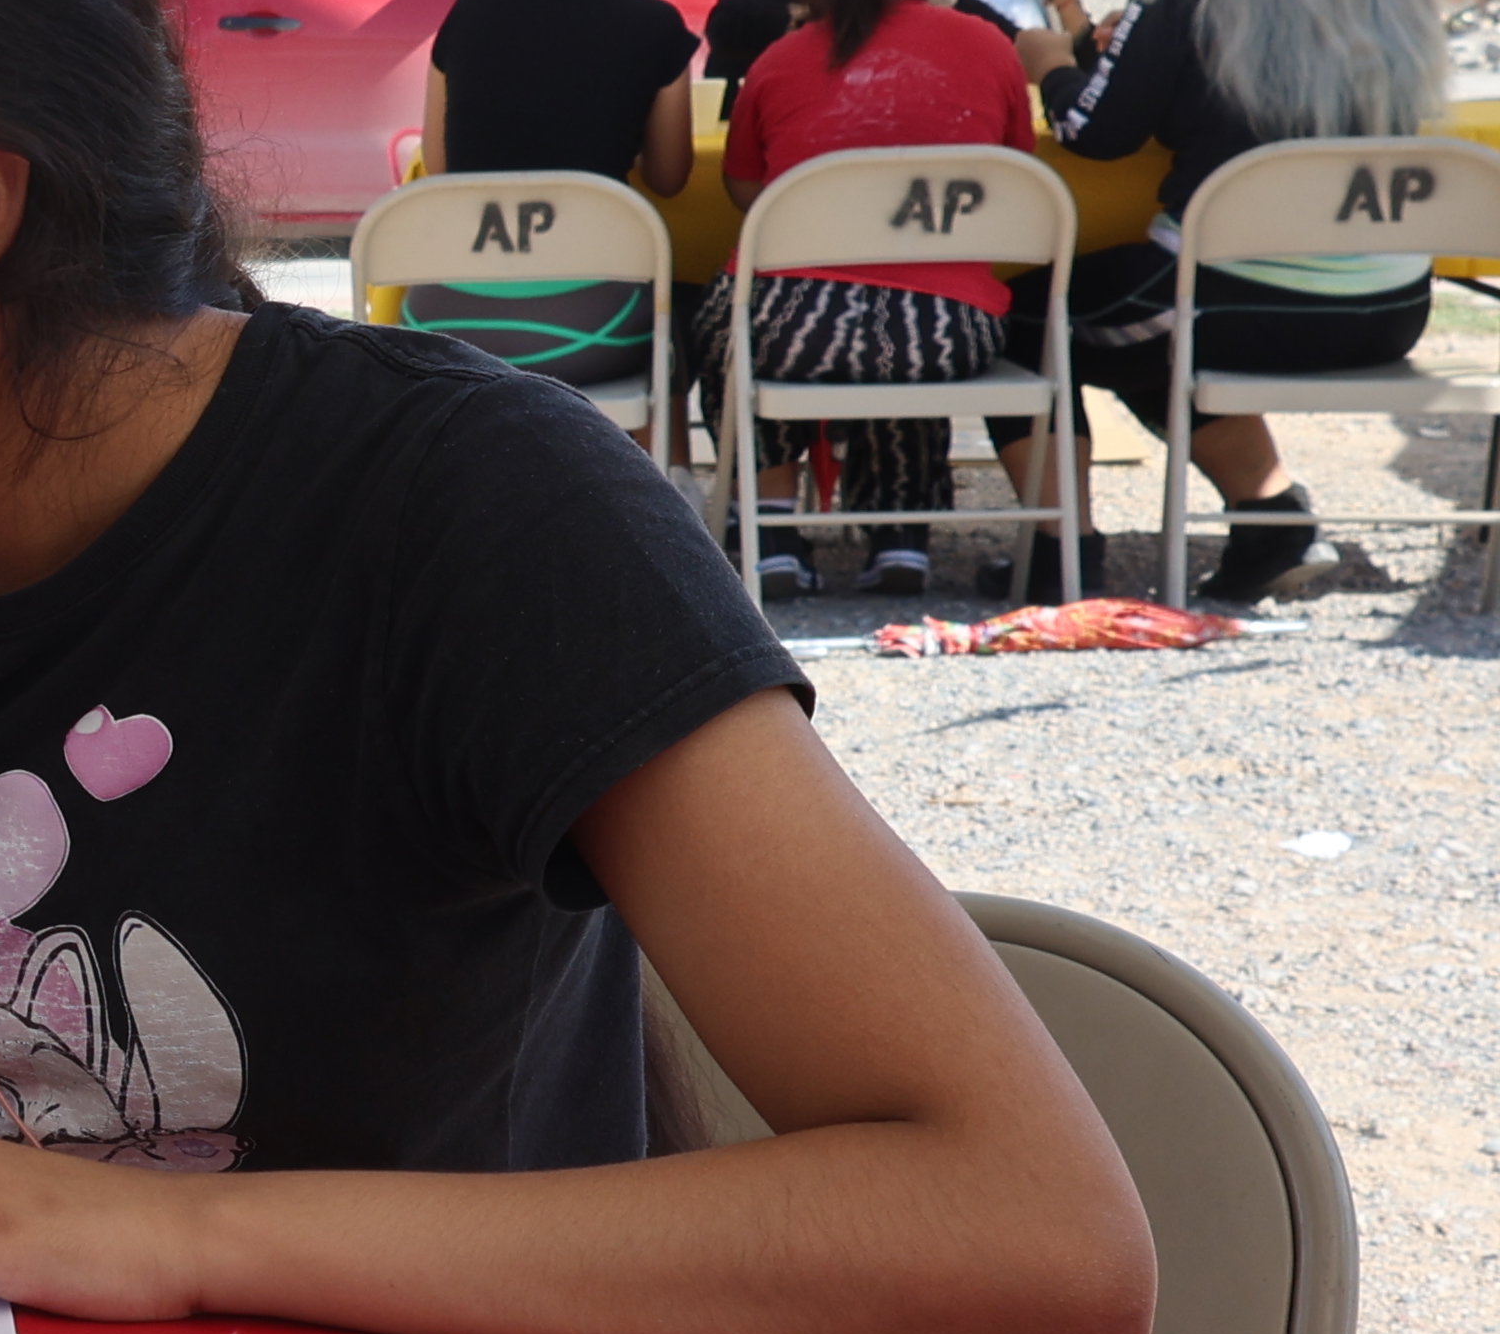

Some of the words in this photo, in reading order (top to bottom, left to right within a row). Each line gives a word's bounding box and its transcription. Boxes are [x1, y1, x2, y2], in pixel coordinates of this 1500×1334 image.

[889, 178, 985, 234] AP
[1335, 166, 1436, 223] AP
[471, 200, 556, 253] AP
